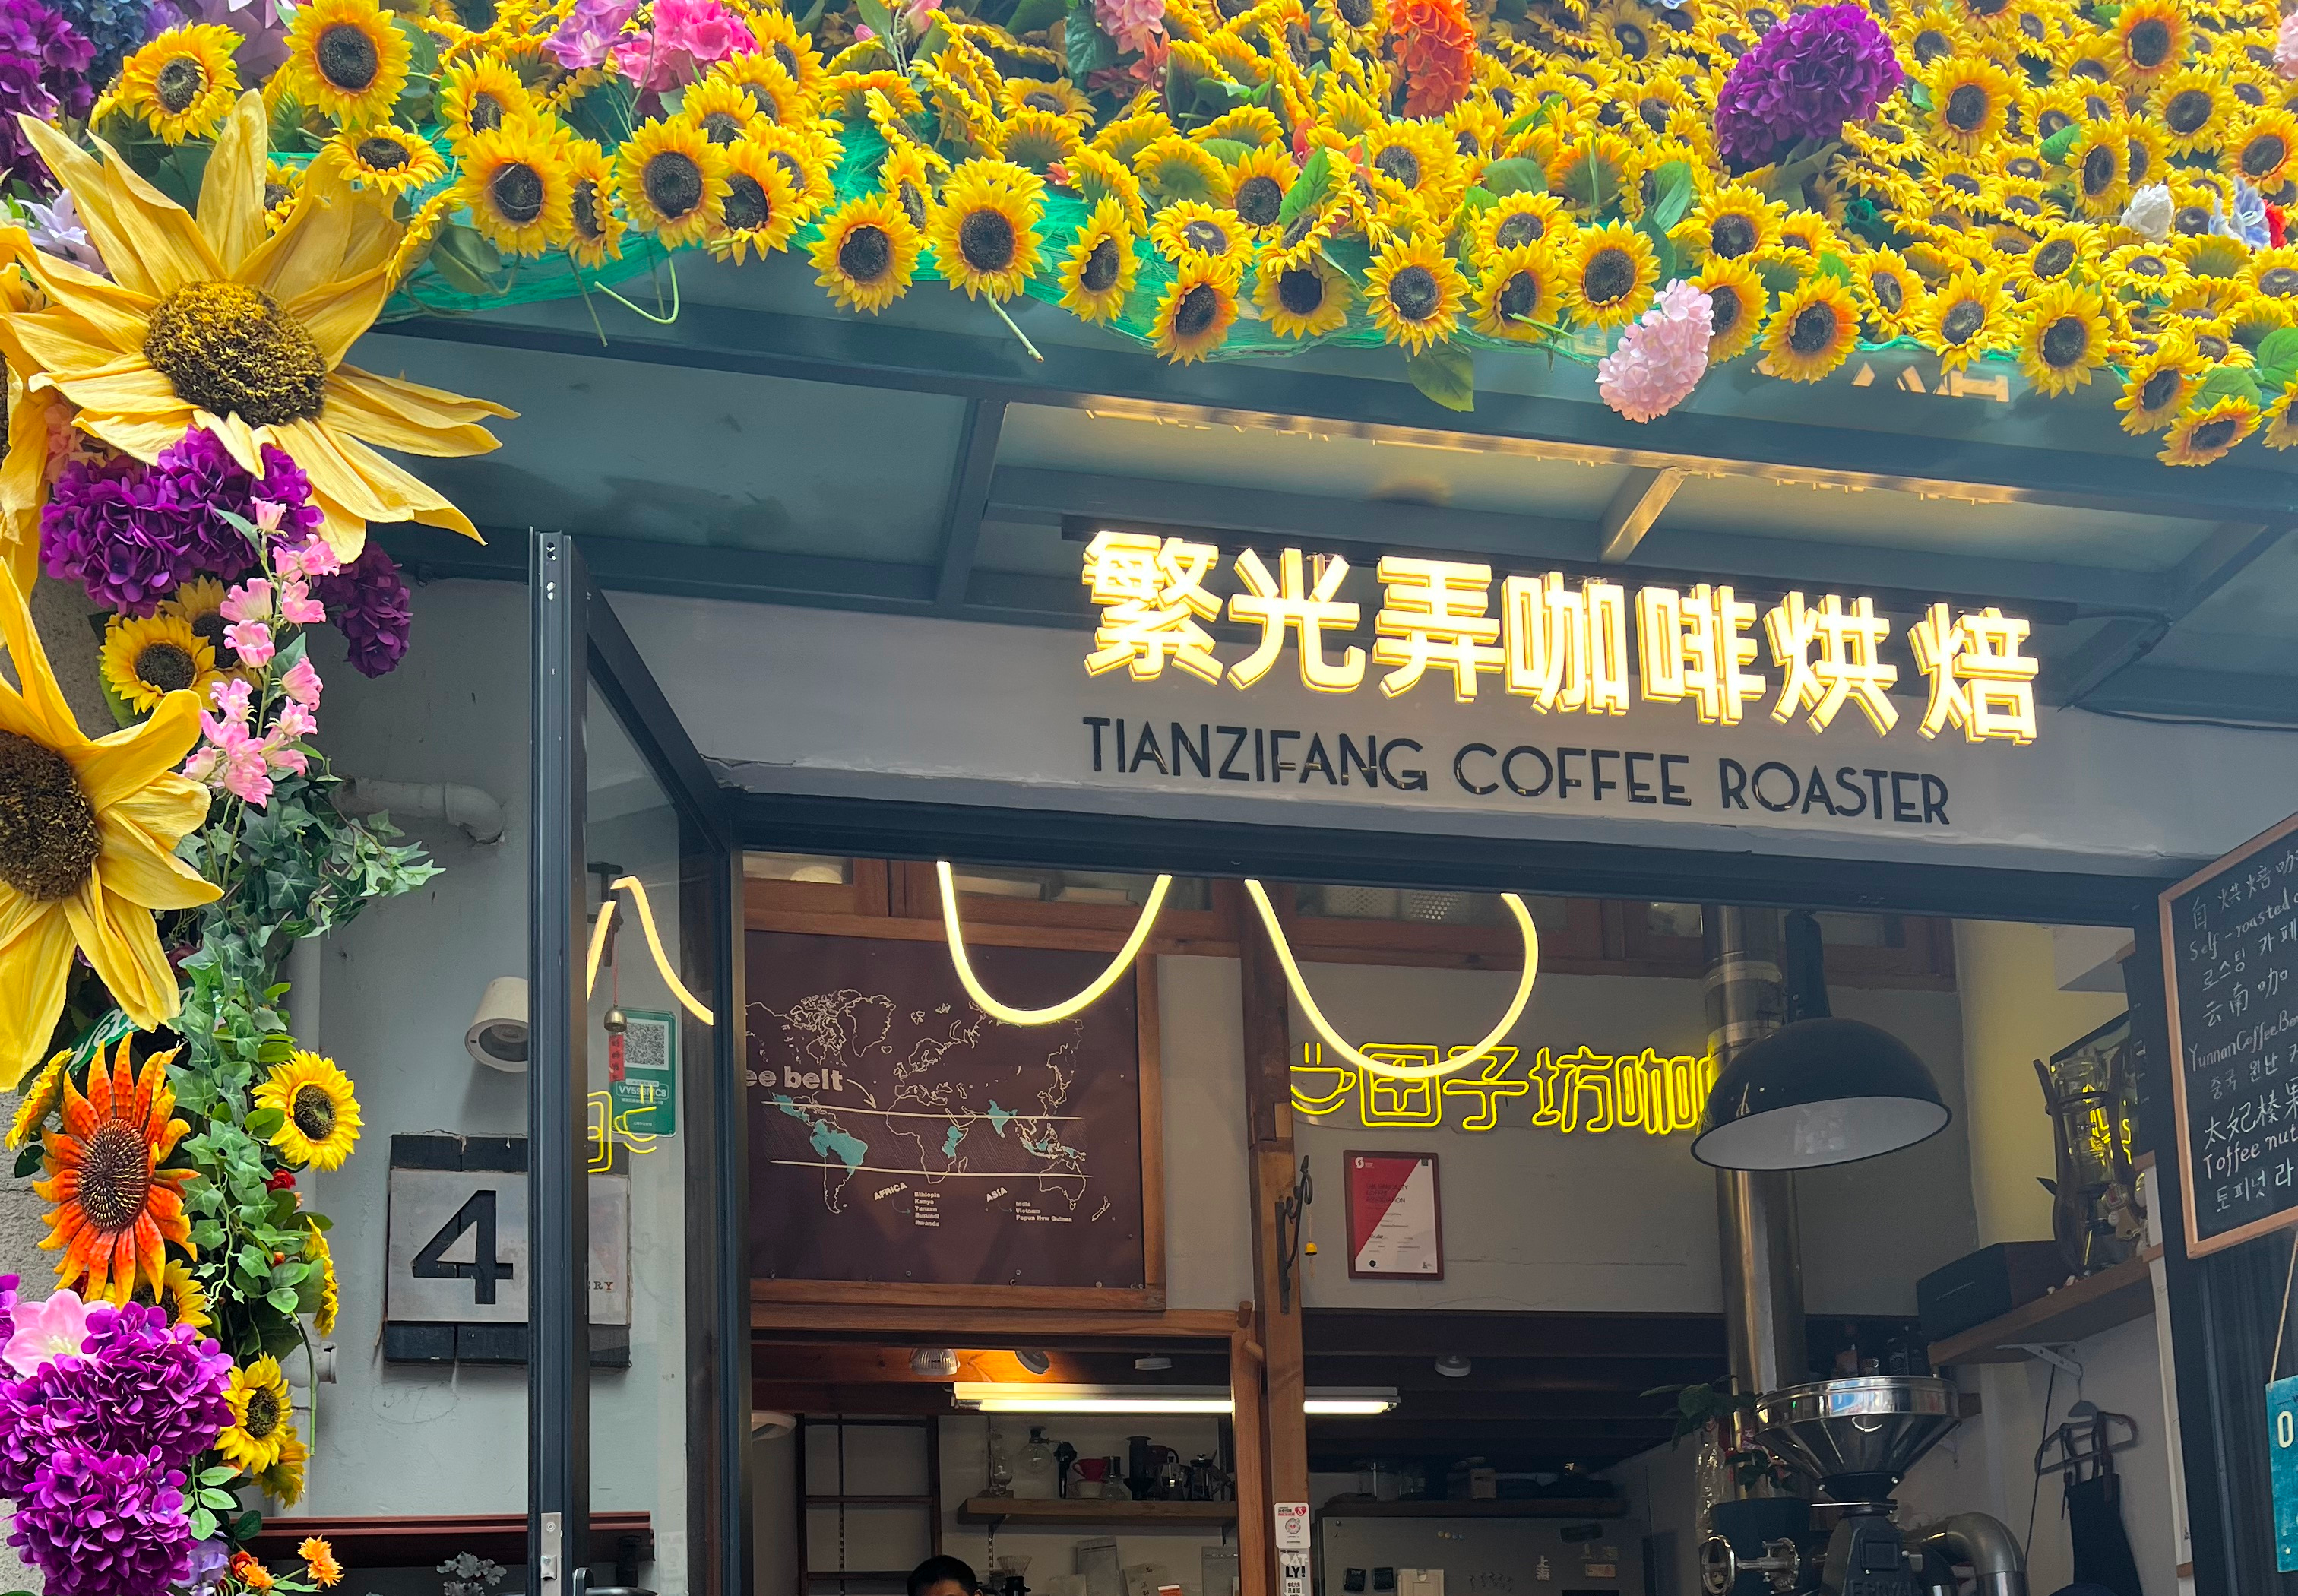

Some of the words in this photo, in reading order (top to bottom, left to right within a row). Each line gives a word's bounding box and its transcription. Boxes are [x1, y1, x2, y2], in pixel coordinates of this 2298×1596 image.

[1082, 530, 2039, 747] 繁光弄咖啡烘焙
[1082, 716, 1429, 793] TIANZIFANG
[1454, 742, 1693, 807] COFFEE
[1721, 758, 1951, 826] ROASTER
[783, 1066, 844, 1091] belt
[1359, 1042, 1714, 1135] 田子坊咖
[2203, 1140, 2262, 1180] Toffee
[874, 1182, 908, 1201] AFRICA
[986, 1187, 1008, 1202] ASIA
[410, 1189, 514, 1305] 4
[1285, 1566, 1306, 1578] LY!
